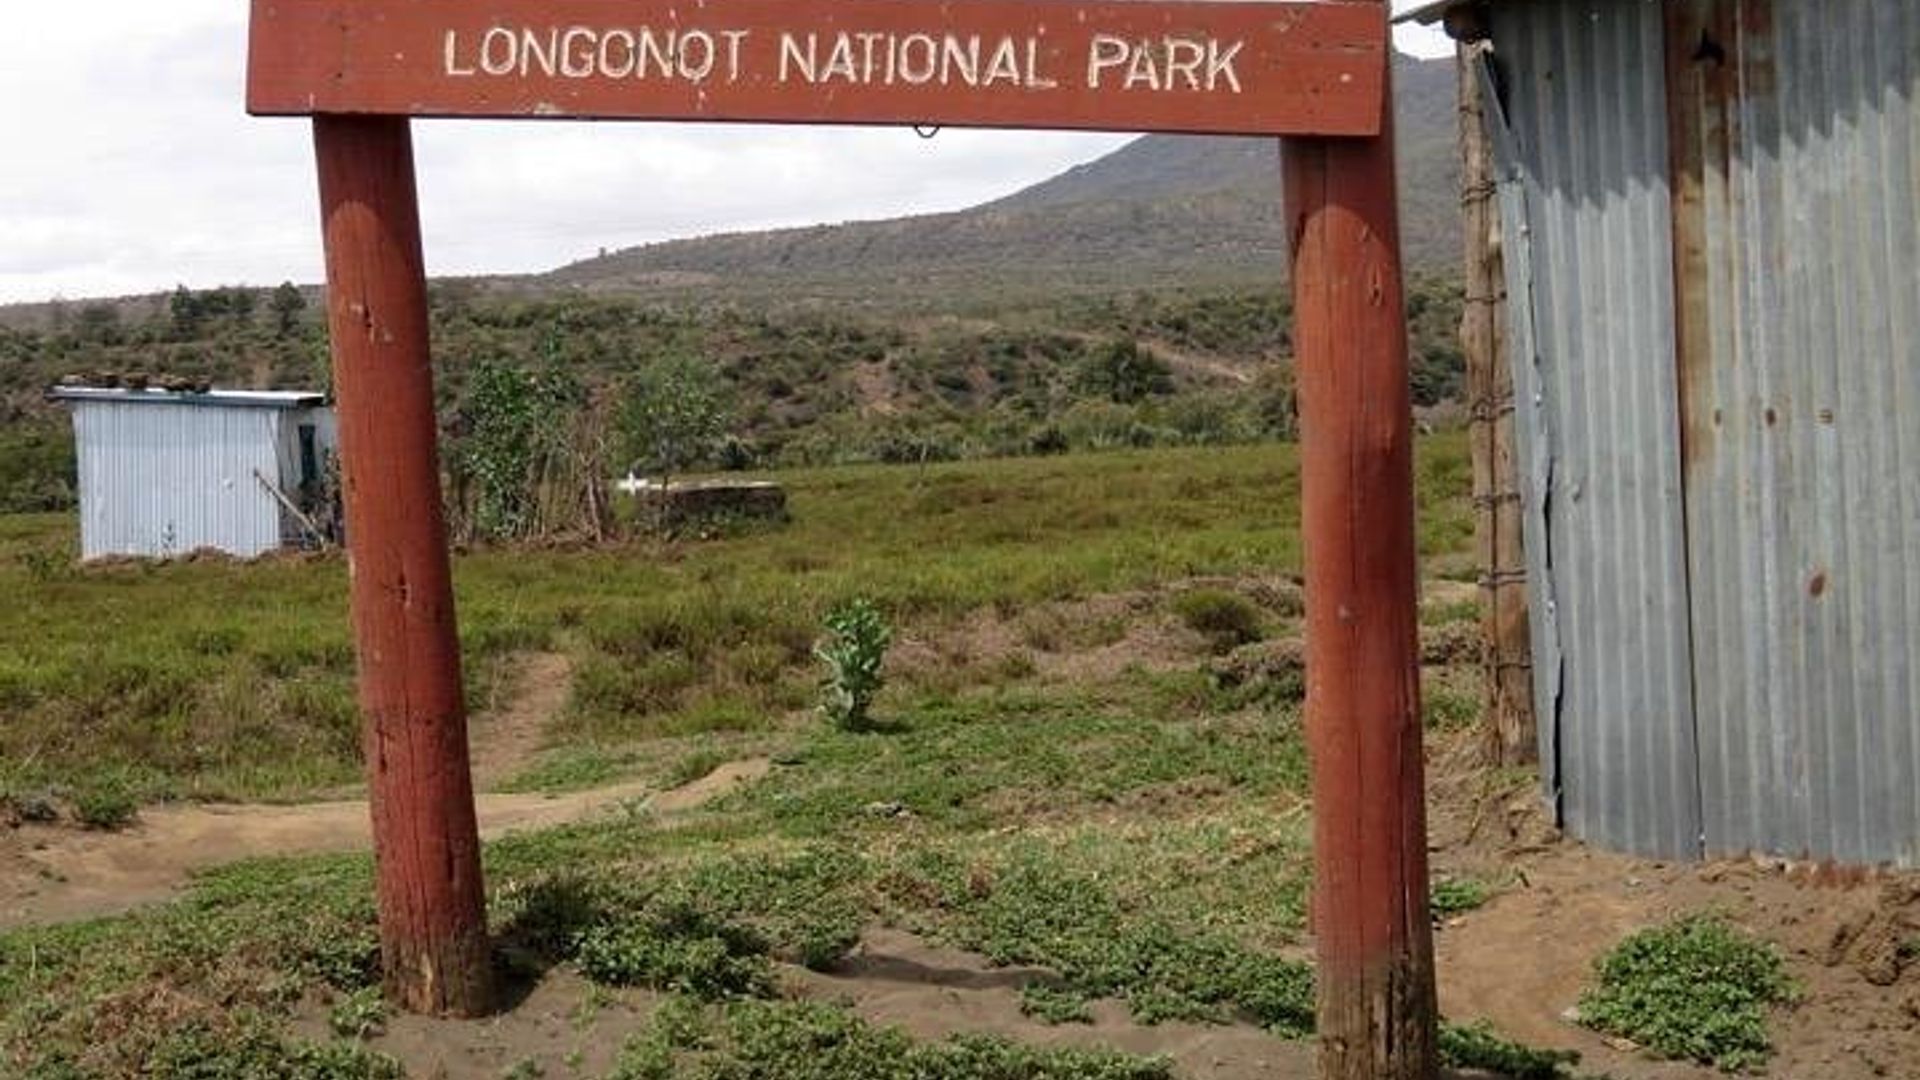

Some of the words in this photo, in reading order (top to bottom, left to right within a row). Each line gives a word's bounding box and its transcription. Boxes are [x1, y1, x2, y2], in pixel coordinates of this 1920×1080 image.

[444, 26, 749, 83] LONGONOT
[779, 31, 1057, 89] NATIONAL
[1088, 34, 1243, 93] PARK
